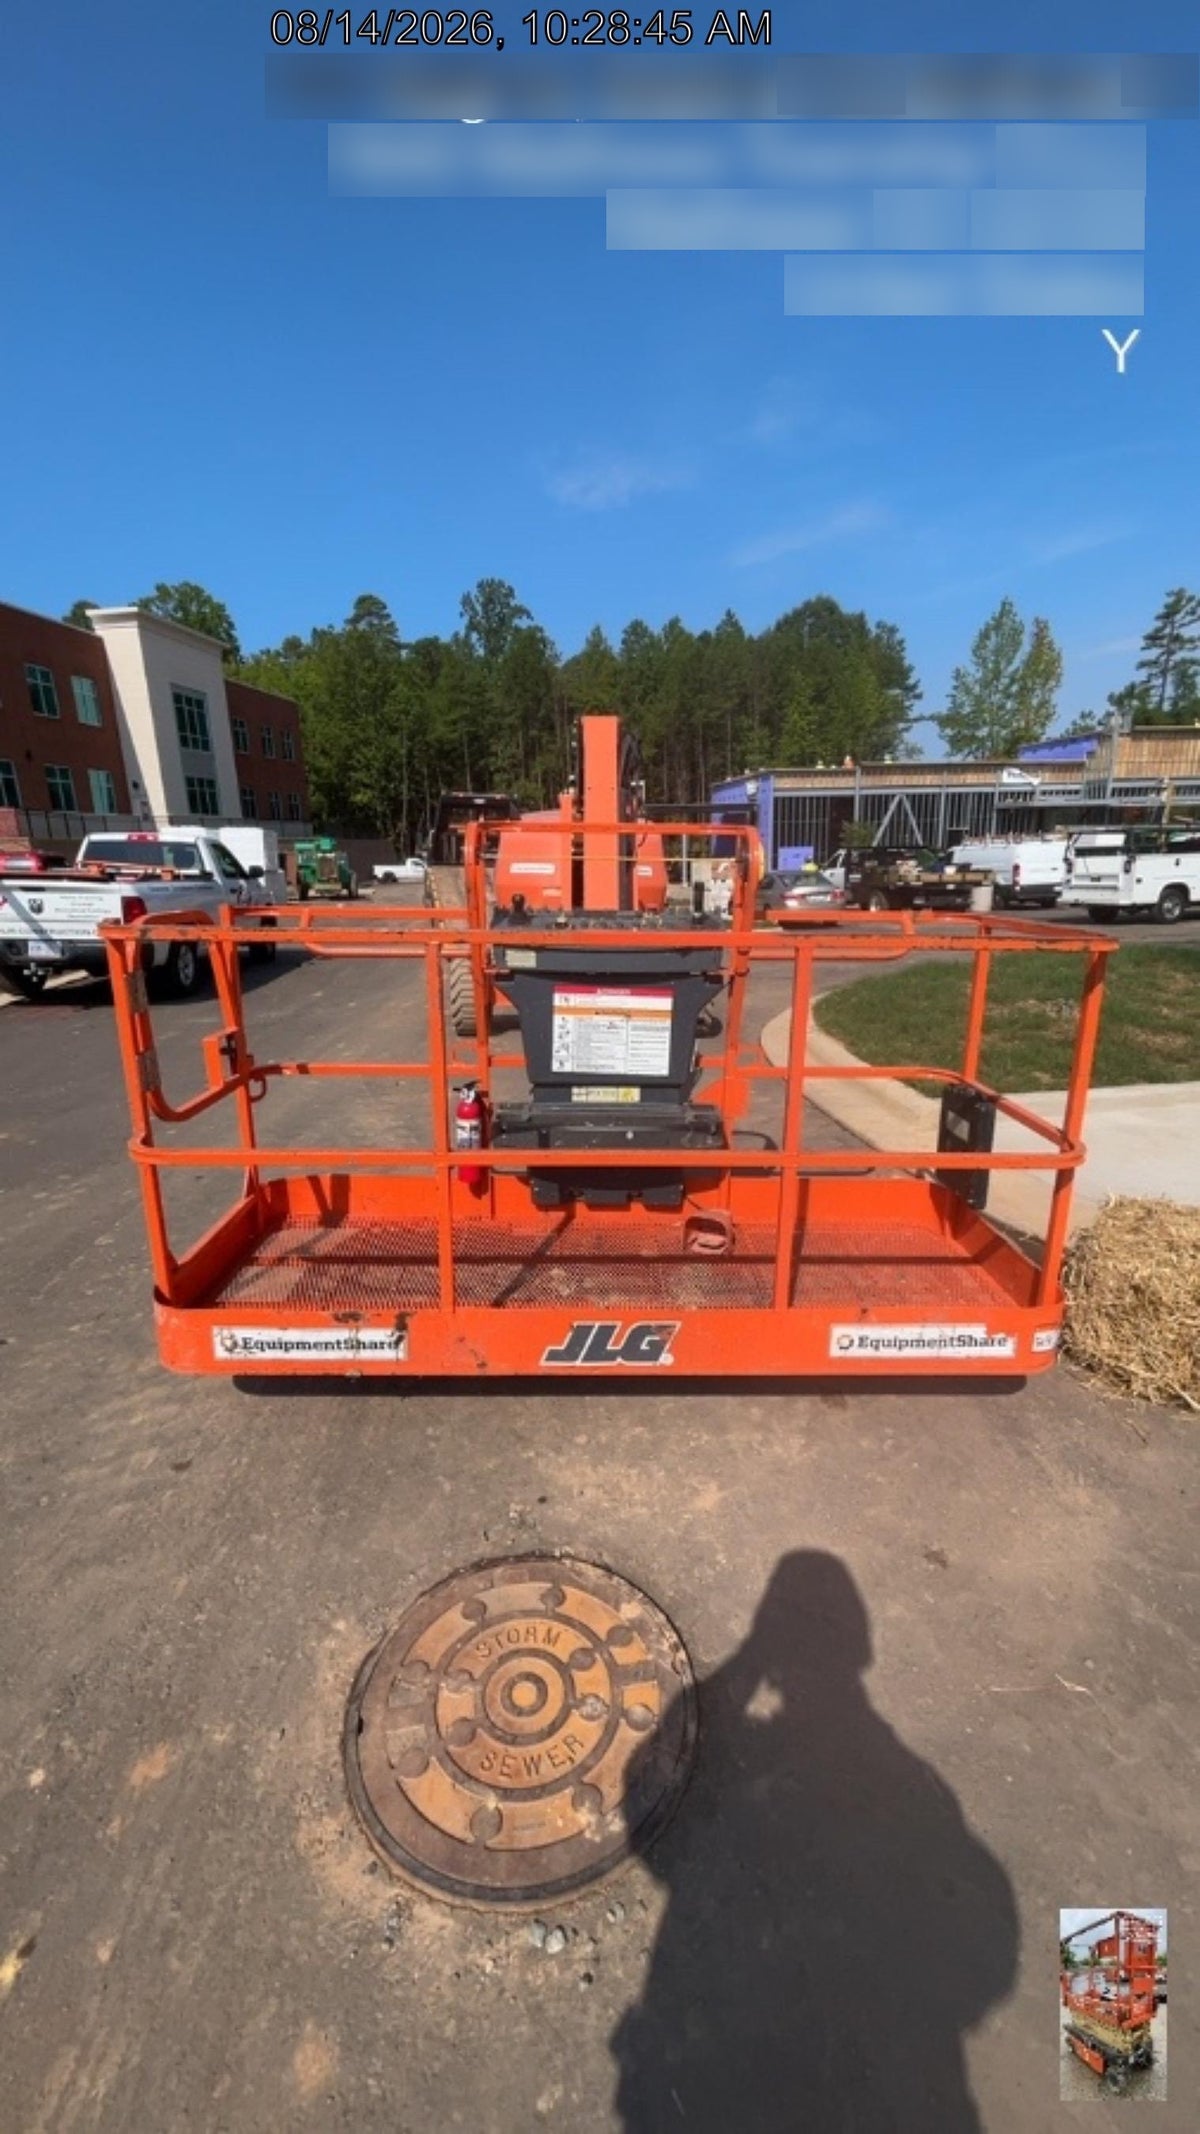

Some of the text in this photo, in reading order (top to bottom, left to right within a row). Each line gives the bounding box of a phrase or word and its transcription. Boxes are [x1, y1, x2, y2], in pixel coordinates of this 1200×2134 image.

[540, 1321, 681, 1366] JLG
[857, 1334, 1008, 1351] EquipmentShare
[476, 1626, 562, 1659] STORM
[480, 1734, 584, 1780] SEWER
